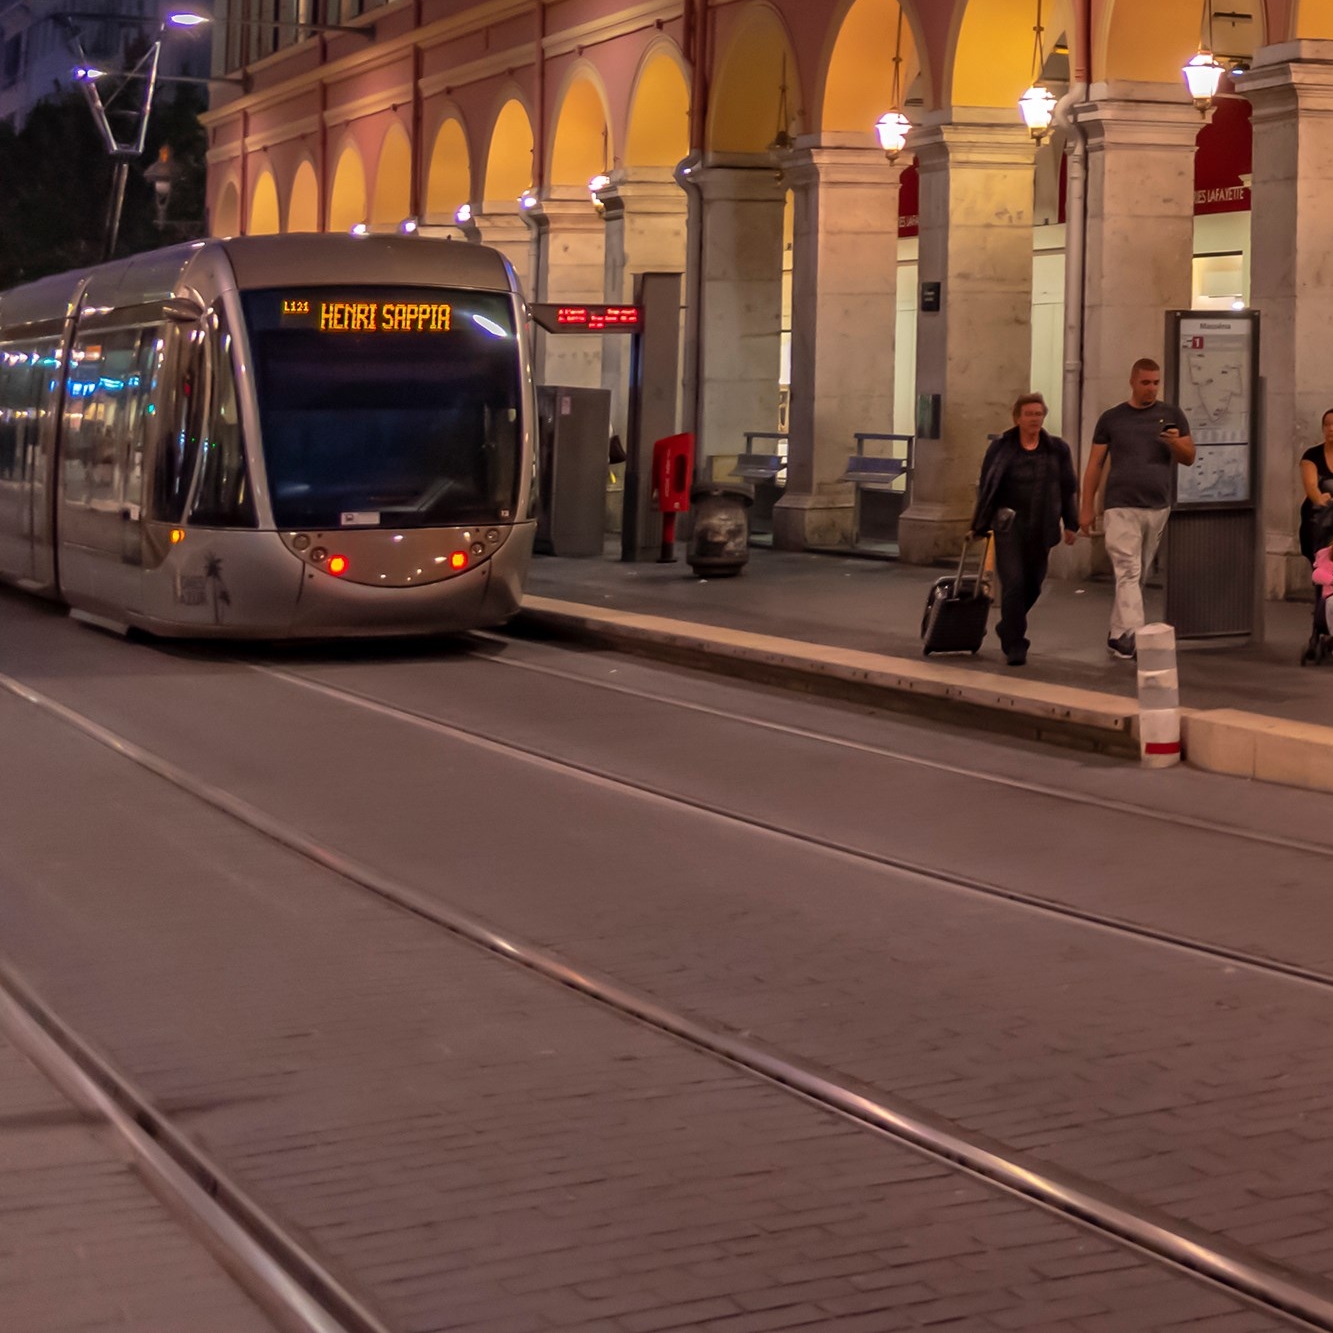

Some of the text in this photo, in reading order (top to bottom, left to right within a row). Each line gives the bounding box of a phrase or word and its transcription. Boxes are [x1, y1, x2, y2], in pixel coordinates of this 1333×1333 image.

[1207, 186, 1244, 203] LAFAYETTE
[321, 303, 451, 330] HENRI SAPPIA
[1195, 338, 1200, 348] 1
